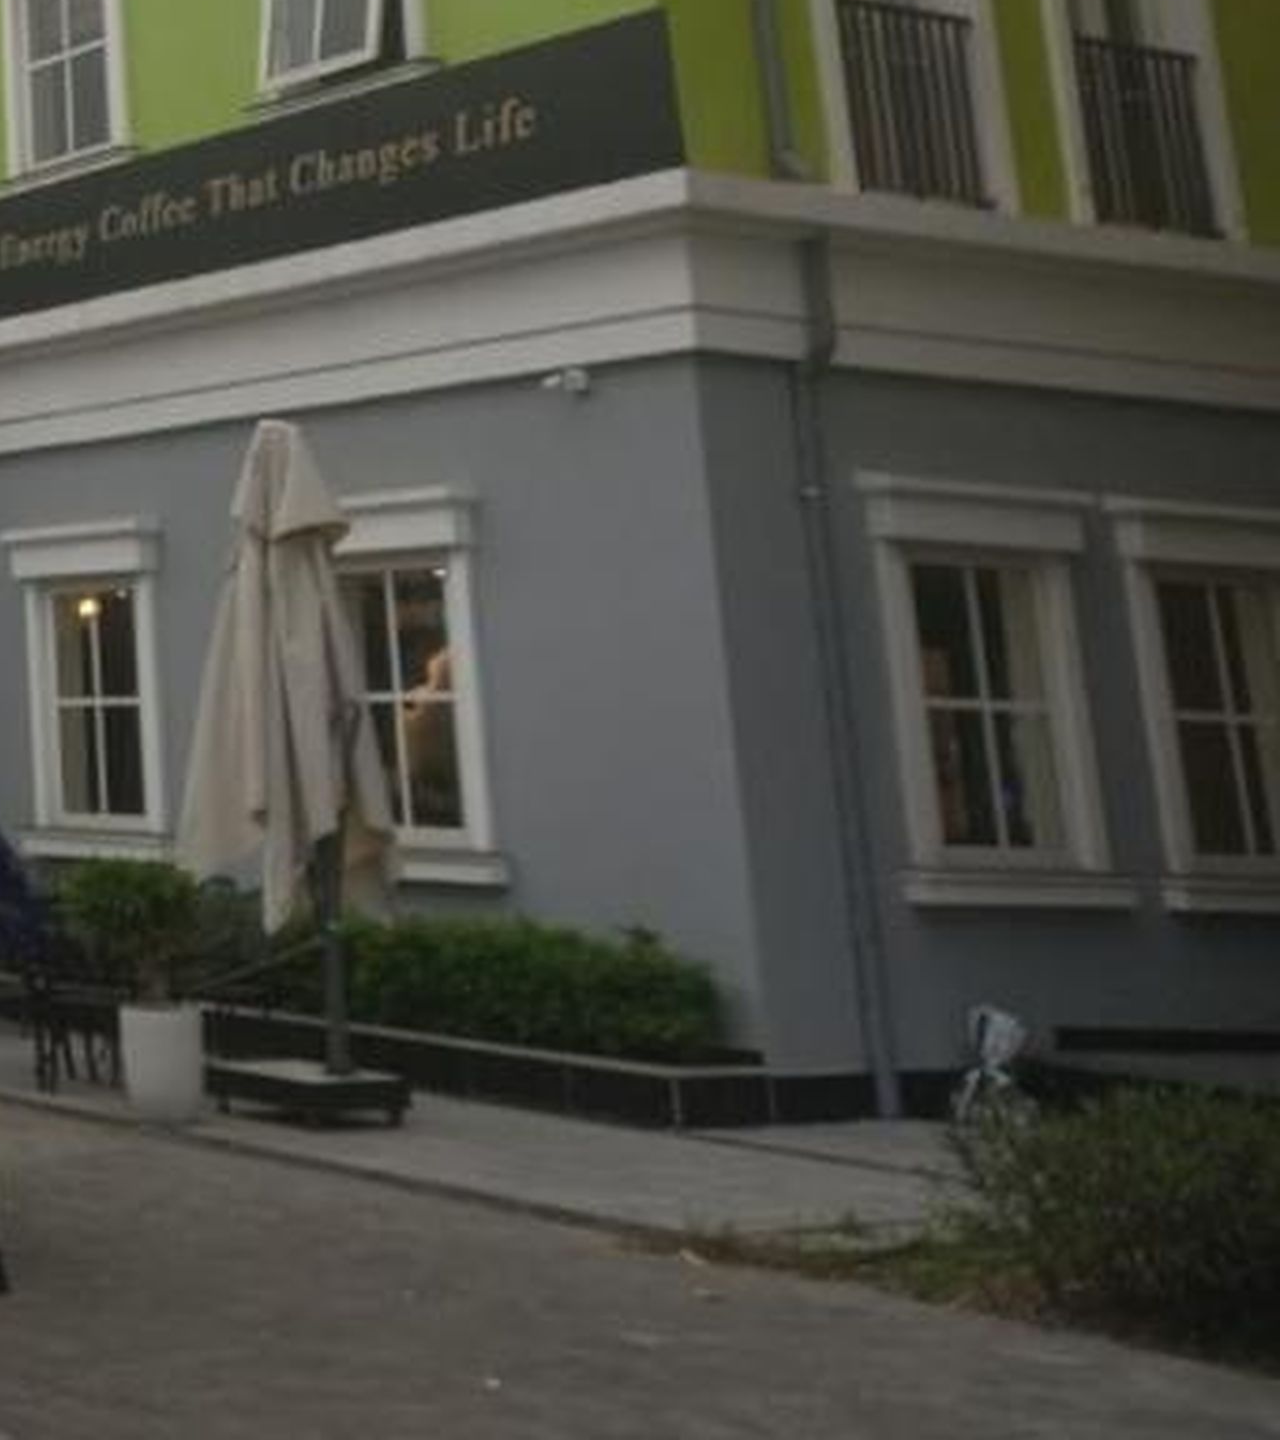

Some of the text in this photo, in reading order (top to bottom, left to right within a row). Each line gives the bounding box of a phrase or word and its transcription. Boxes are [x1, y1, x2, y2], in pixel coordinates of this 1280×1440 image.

[97, 193, 198, 242] Coffee
[208, 164, 279, 218] That
[289, 130, 442, 195] Changes
[454, 96, 538, 158] Life
